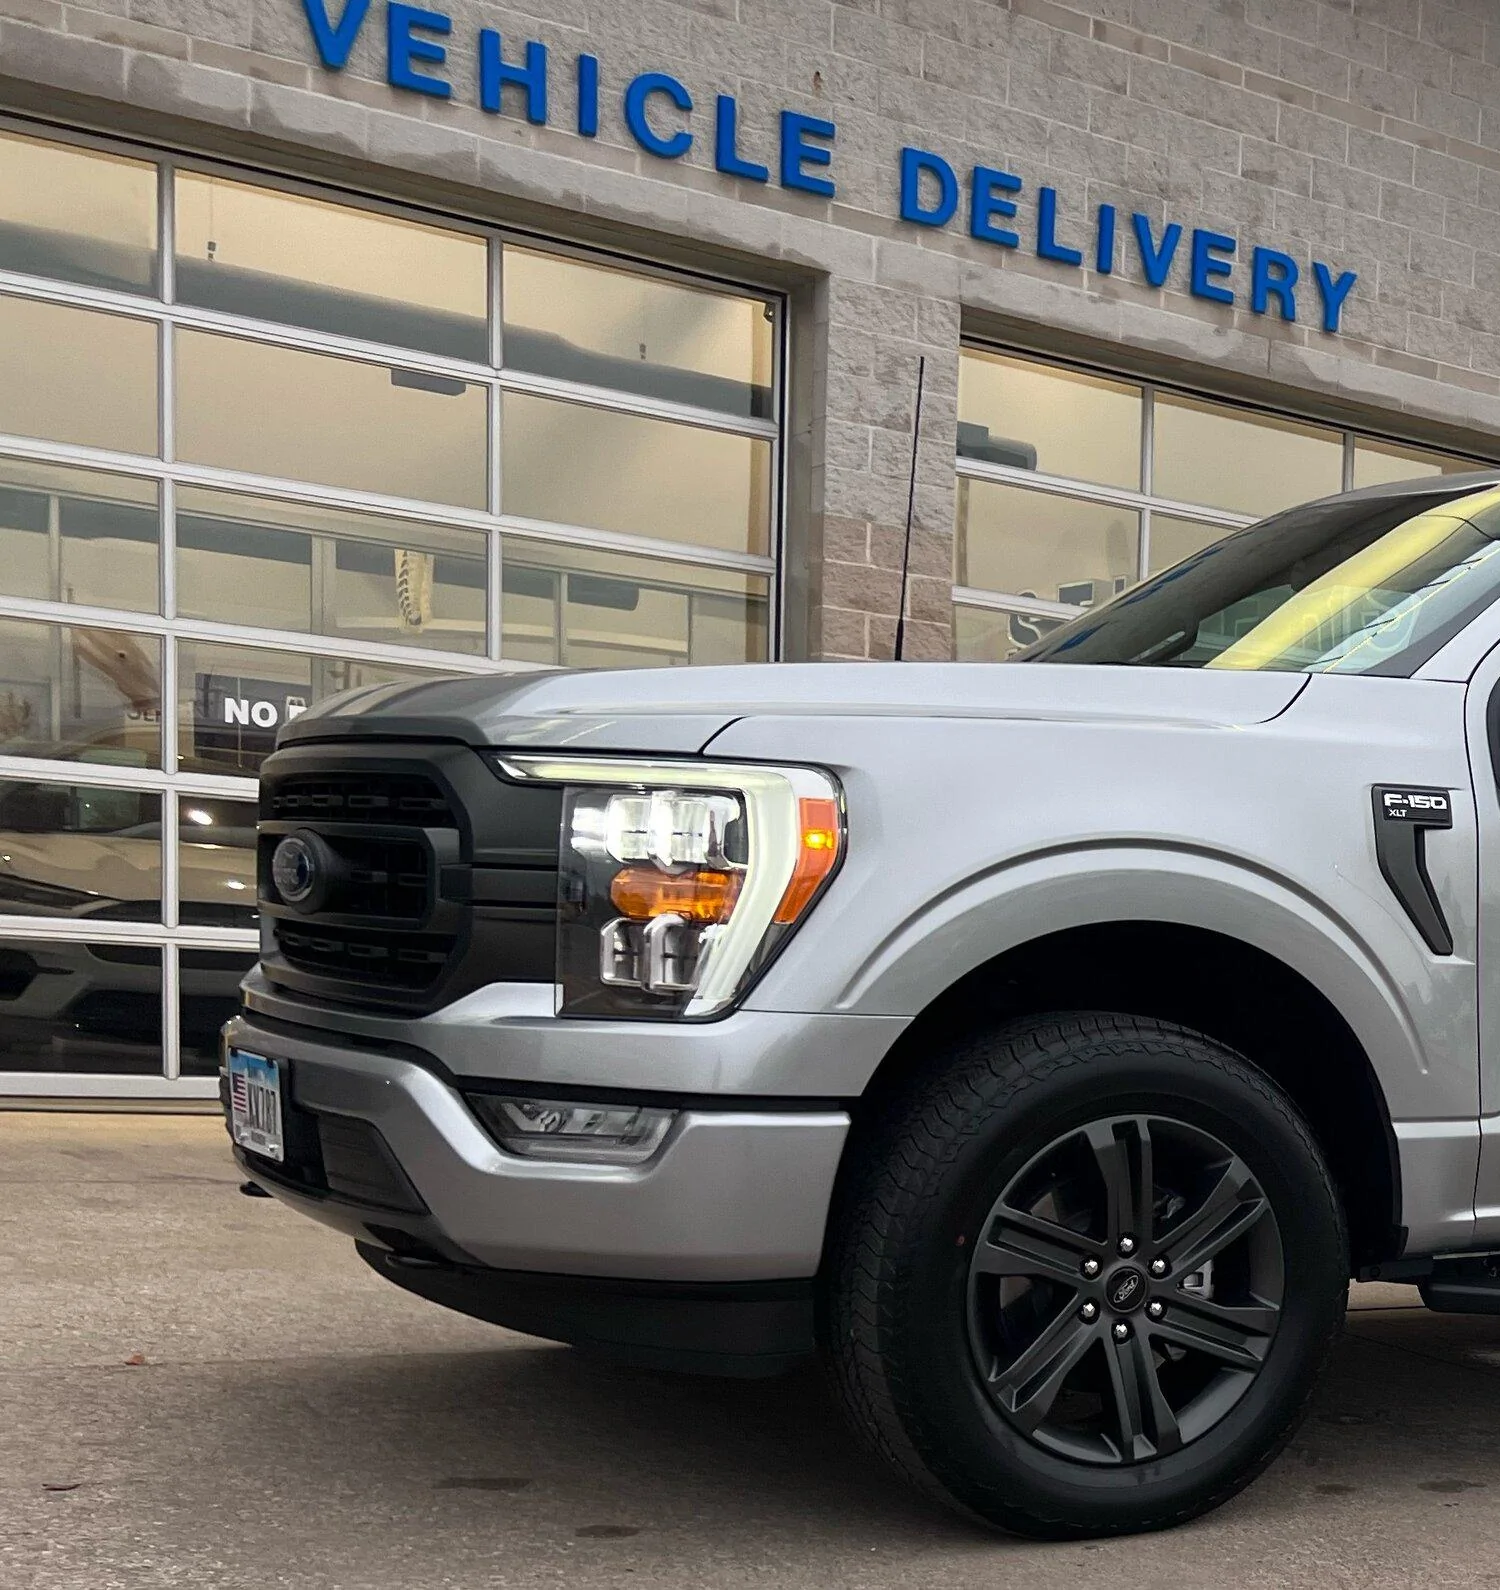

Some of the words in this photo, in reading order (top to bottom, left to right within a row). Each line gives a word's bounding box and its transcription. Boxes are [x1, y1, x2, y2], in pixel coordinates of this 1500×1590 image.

[302, 0, 835, 198] VEHICLE
[900, 147, 1358, 332] DELIVERY
[224, 697, 278, 728] NO
[1383, 793, 1447, 810] F-150
[1388, 808, 1407, 818] XLT
